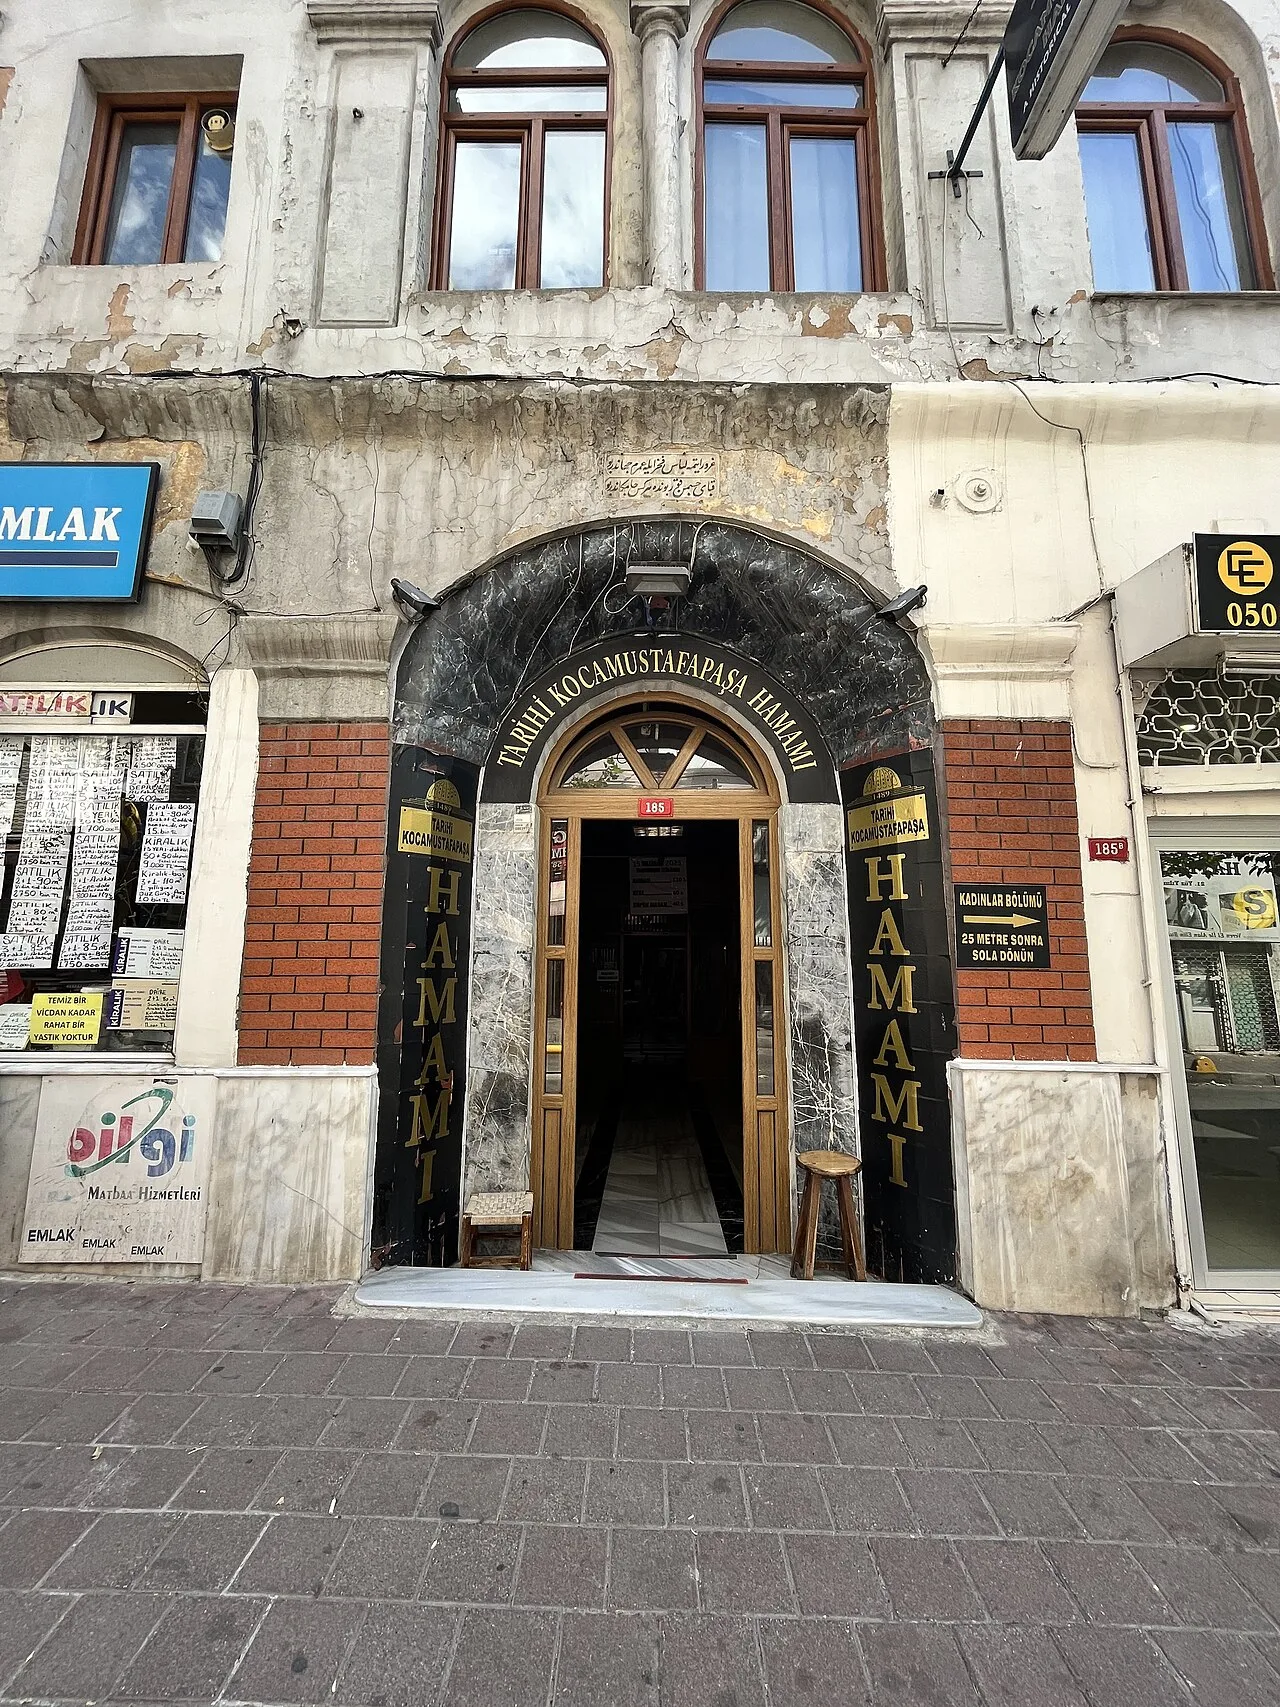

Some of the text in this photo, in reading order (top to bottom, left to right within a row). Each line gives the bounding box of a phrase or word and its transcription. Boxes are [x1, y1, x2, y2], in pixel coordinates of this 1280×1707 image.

[1226, 602, 1278, 627] 050
[497, 648, 818, 773] TARİHİ KOCAMUSTAFAPAŞA HAMAMI
[645, 802, 665, 813] 185
[850, 818, 926, 844] KOCAMUSTAFAPAŞA
[402, 830, 470, 858] KOCAMUSTAFAPAŞA
[960, 891, 1042, 908] KADINLAR BÖLÜMÜ
[961, 933, 1043, 946] 25 METRE SONRA
[115, 938, 129, 973] KİRALIK
[972, 947, 1034, 962] SOLA DÖNÜN
[48, 996, 86, 1004] TEMİZ BİR
[36, 1007, 66, 1016] VİCDAN
[110, 990, 123, 1026] KİRALIK
[44, 1020, 85, 1029] RAHAT BİR
[34, 1033, 93, 1041] YASTIK YOKTUR
[27, 1228, 75, 1242] EMLAK
[82, 1239, 116, 1248] EMLAK
[131, 1246, 165, 1255] EMLAK
